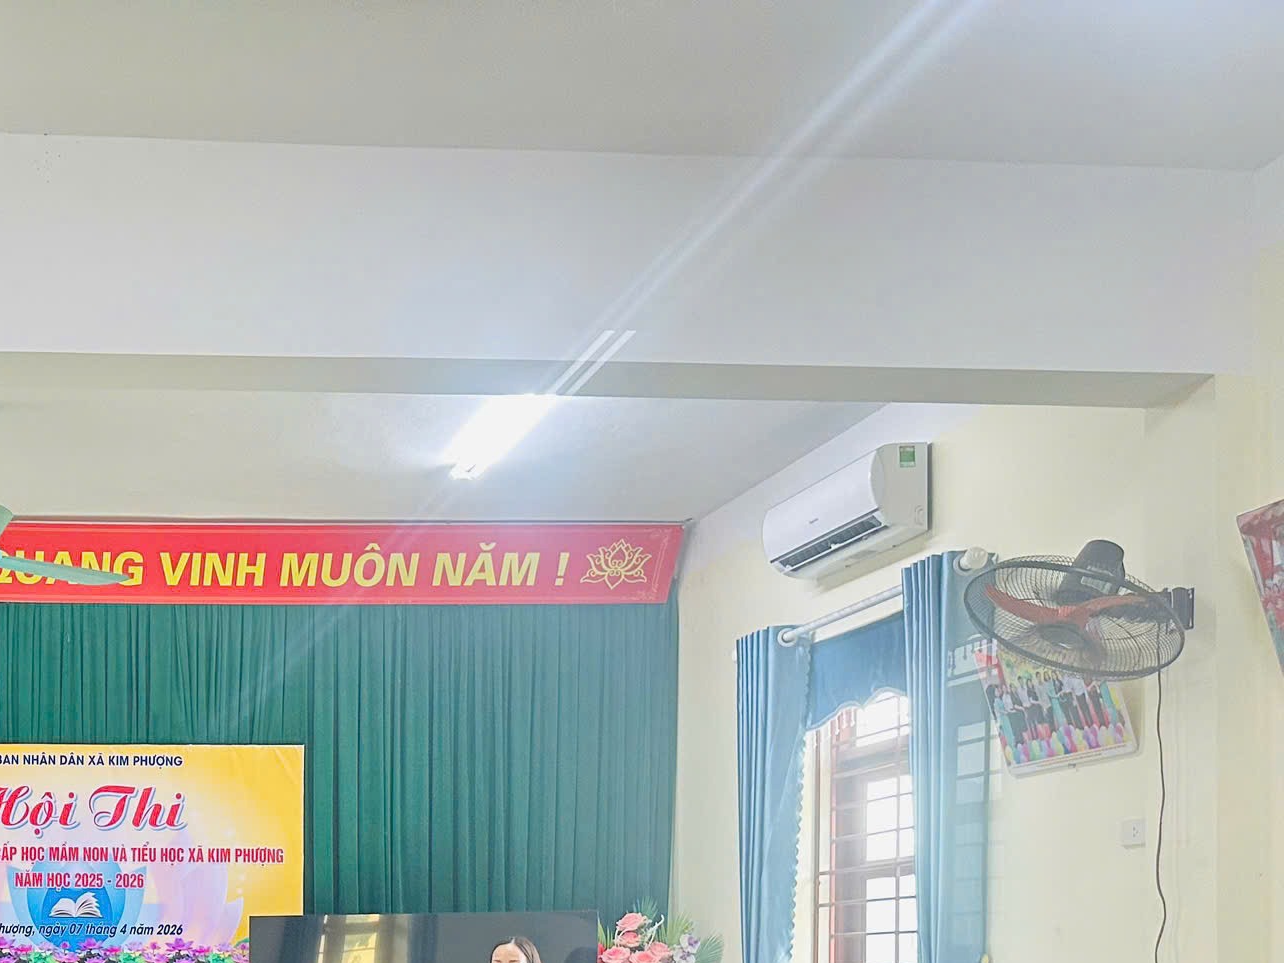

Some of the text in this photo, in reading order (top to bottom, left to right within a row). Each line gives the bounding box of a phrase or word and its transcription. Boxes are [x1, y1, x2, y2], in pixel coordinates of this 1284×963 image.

[159, 552, 267, 587] VINH
[279, 543, 420, 587] MUÔN
[431, 542, 541, 587] NĂM
[554, 552, 570, 586] !
[23, 752, 56, 766] NHÂN
[59, 752, 85, 766] DÂN
[88, 752, 105, 766] XÃ
[108, 755, 129, 766] KIM
[133, 754, 183, 770] PHƯỢNG
[88, 784, 188, 832] Thi
[21, 846, 45, 865] HỌC
[83, 847, 109, 862] NON
[112, 844, 128, 862] VÀ
[131, 841, 157, 862] TIỂU
[160, 848, 185, 866] HỌC
[188, 845, 204, 863] XÃ
[207, 848, 231, 863] KIM
[234, 848, 284, 867] PHƯỢNG
[15, 870, 43, 888] NĂM
[46, 872, 71, 892] HỌC
[74, 873, 104, 888] 2025
[115, 873, 144, 888] 2026
[38, 922, 67, 937] ngày
[69, 923, 83, 935] 07
[85, 922, 117, 938] tháng
[119, 924, 128, 935] 4
[129, 923, 154, 936] năm
[156, 924, 184, 936] 2026
